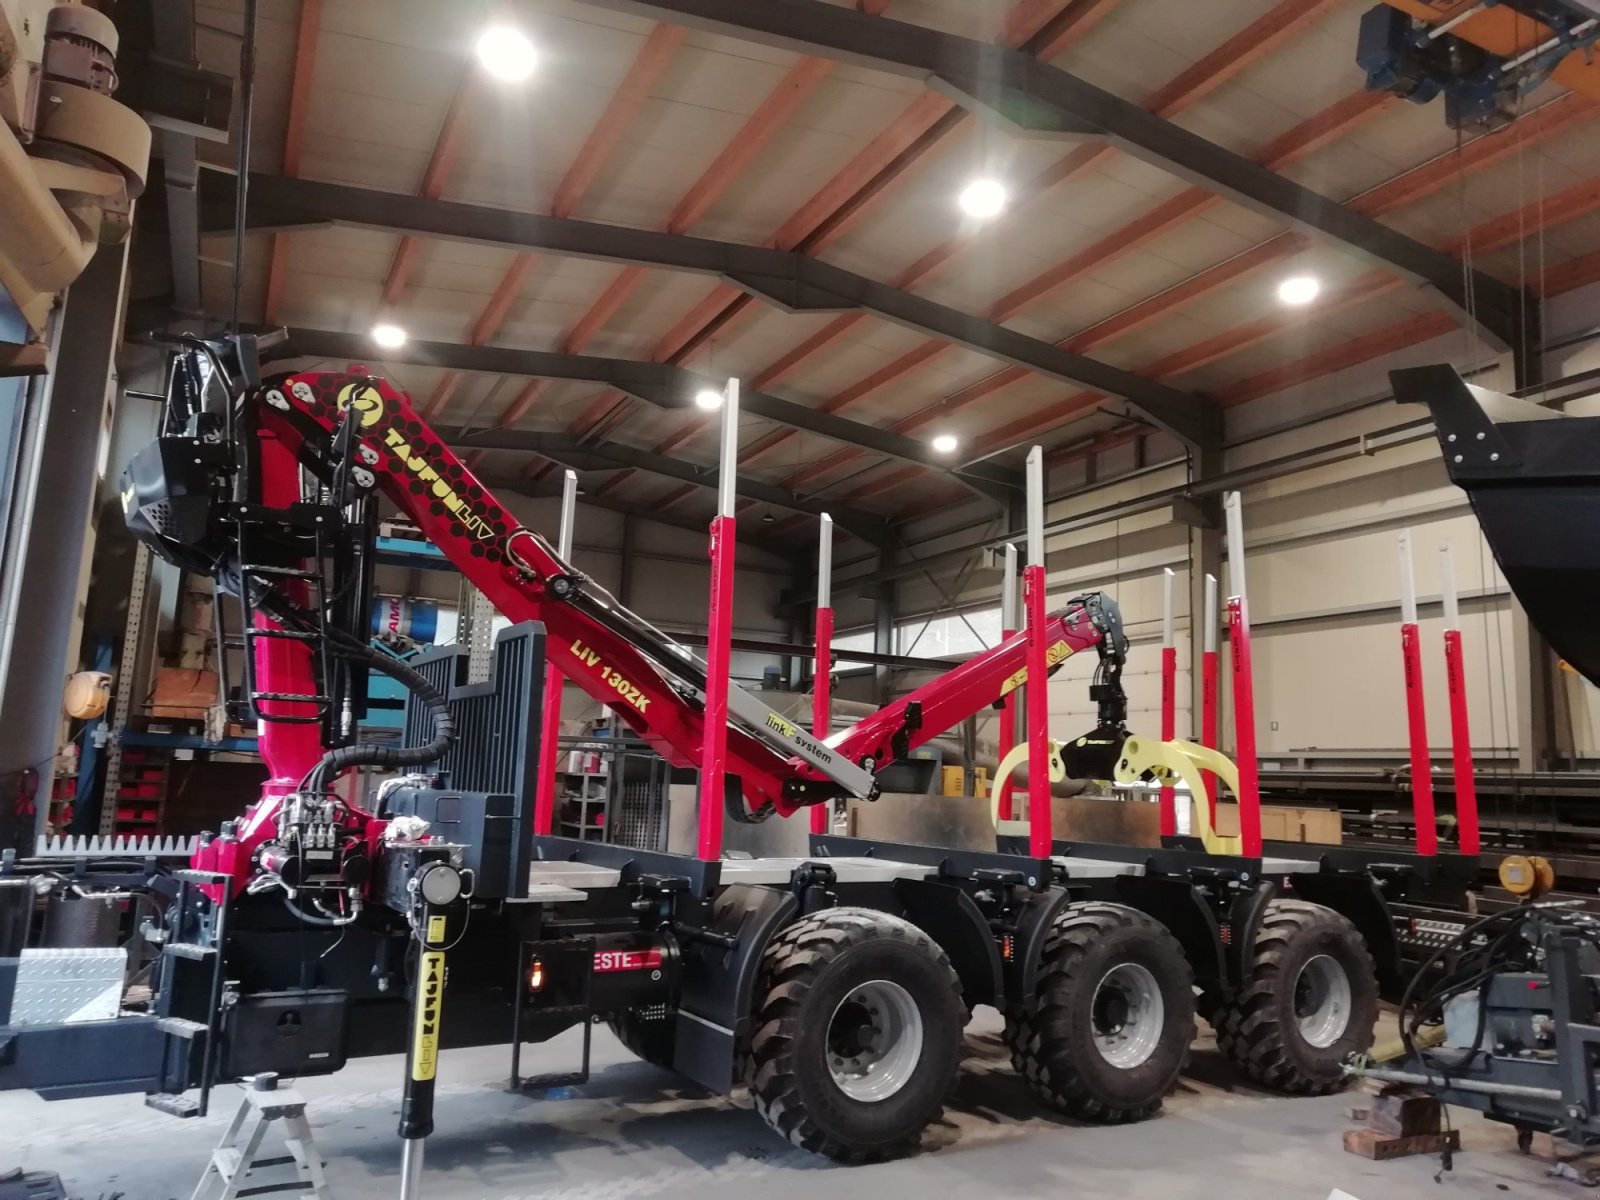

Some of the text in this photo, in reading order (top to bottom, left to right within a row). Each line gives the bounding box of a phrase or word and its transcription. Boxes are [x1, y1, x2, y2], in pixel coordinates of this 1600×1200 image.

[570, 639, 652, 714] LIV 130ZK
[794, 736, 833, 764] system
